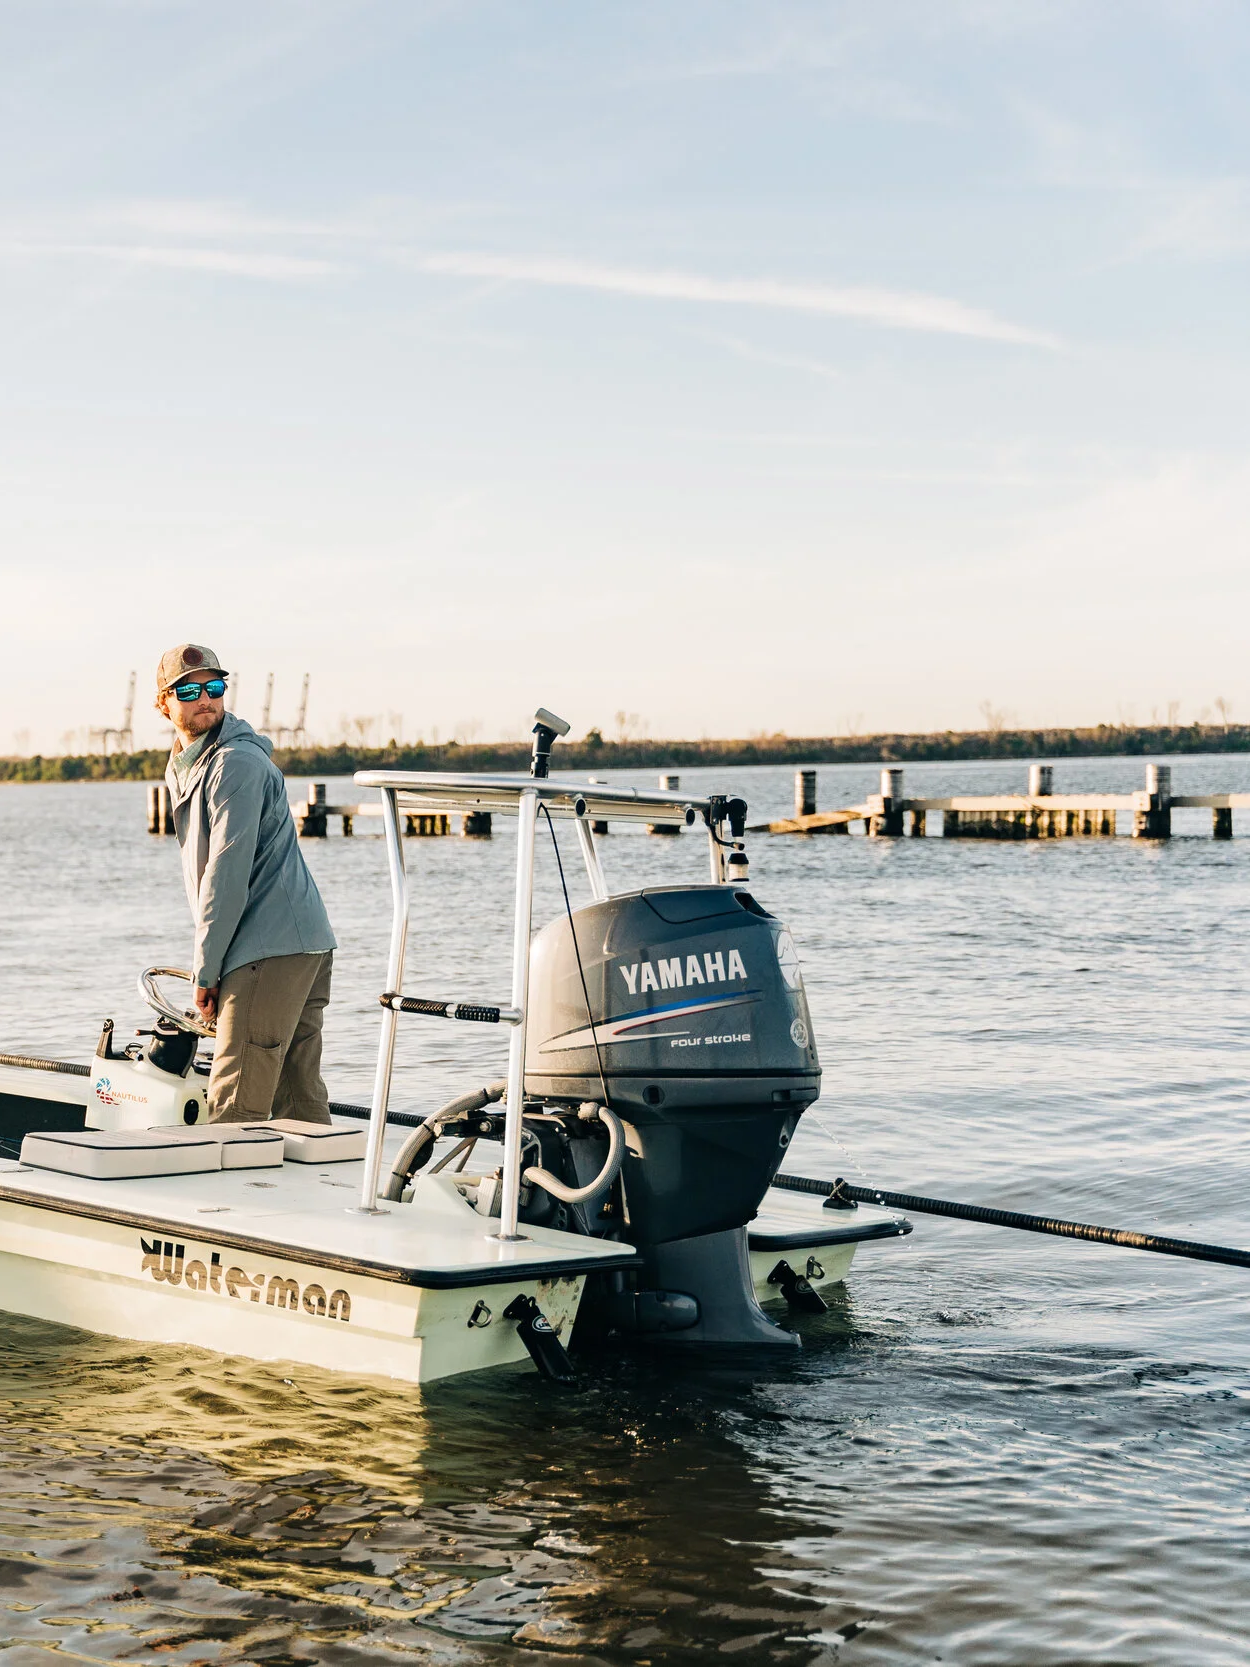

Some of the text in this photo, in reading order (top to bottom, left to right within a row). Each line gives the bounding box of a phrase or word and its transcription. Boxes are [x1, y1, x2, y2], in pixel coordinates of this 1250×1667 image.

[619, 949, 748, 995] YAMAHA
[111, 1091, 148, 1104] NAUTILUS
[139, 1236, 352, 1322] Waterman
